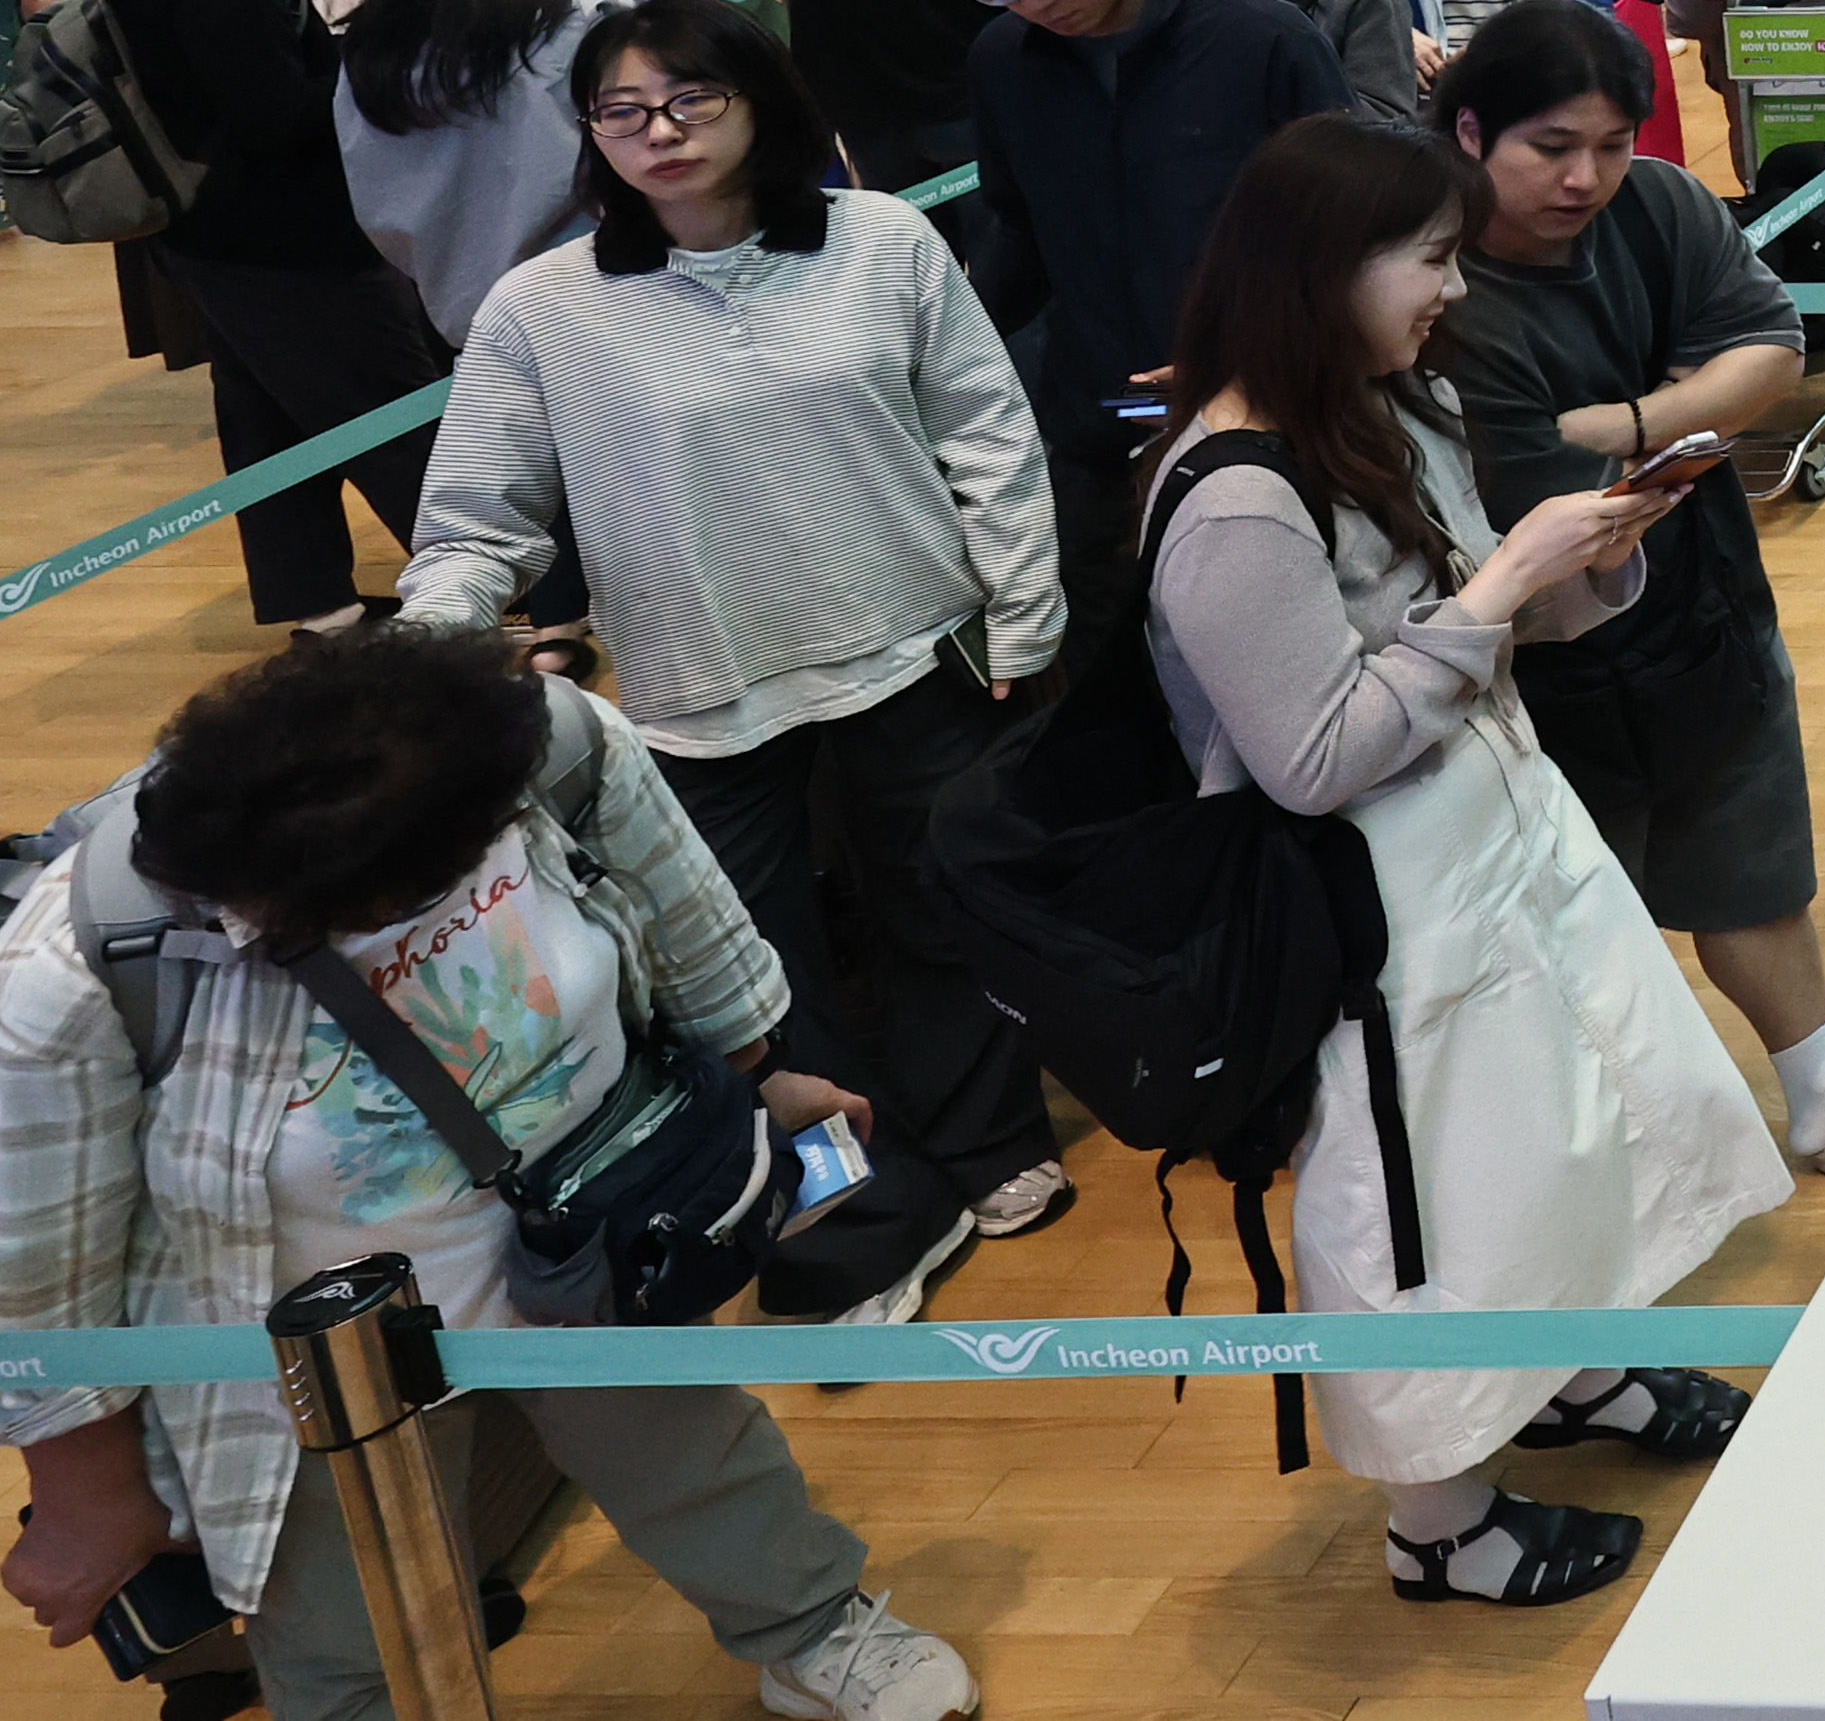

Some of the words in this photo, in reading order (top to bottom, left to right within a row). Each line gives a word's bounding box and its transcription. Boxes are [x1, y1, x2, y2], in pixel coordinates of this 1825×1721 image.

[1756, 30, 1777, 39] YOU
[1779, 29, 1809, 39] KNOW
[1767, 42, 1779, 52] TO
[1781, 42, 1813, 52] ENJOY
[941, 172, 980, 195] Airport
[50, 535, 140, 588] Incheon
[147, 499, 223, 546] Airport
[1057, 1343, 1189, 1368] Incheon
[1203, 1340, 1323, 1369] Airport
